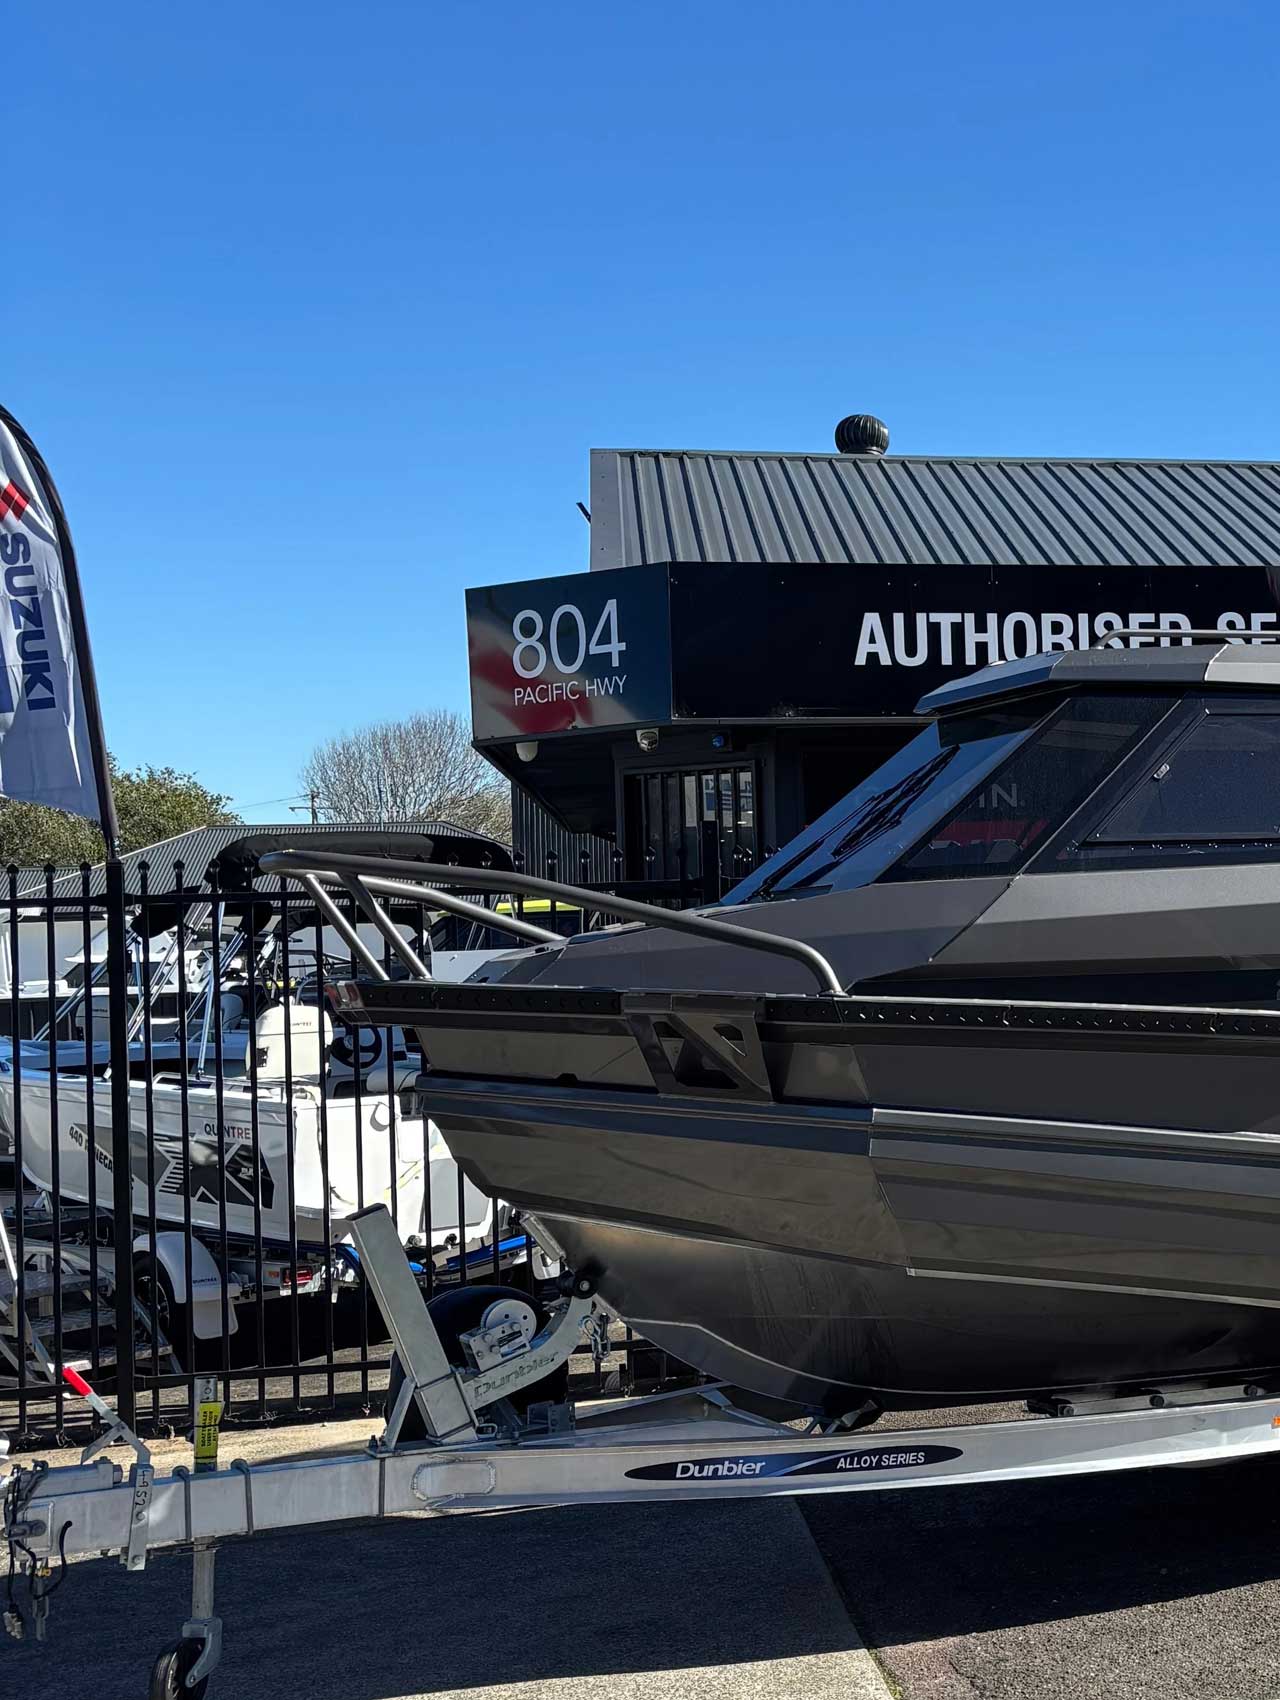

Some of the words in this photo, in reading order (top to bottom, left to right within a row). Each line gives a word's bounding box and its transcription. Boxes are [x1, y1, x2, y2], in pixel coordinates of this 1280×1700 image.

[0, 532, 57, 711] SUZUKI
[511, 598, 627, 680] 804
[513, 680, 580, 707] PACIFIC
[585, 673, 628, 698] HWY
[675, 1459, 766, 1479] Dunbier
[836, 1455, 880, 1470] ALLOY
[881, 1452, 926, 1467] SERIES
